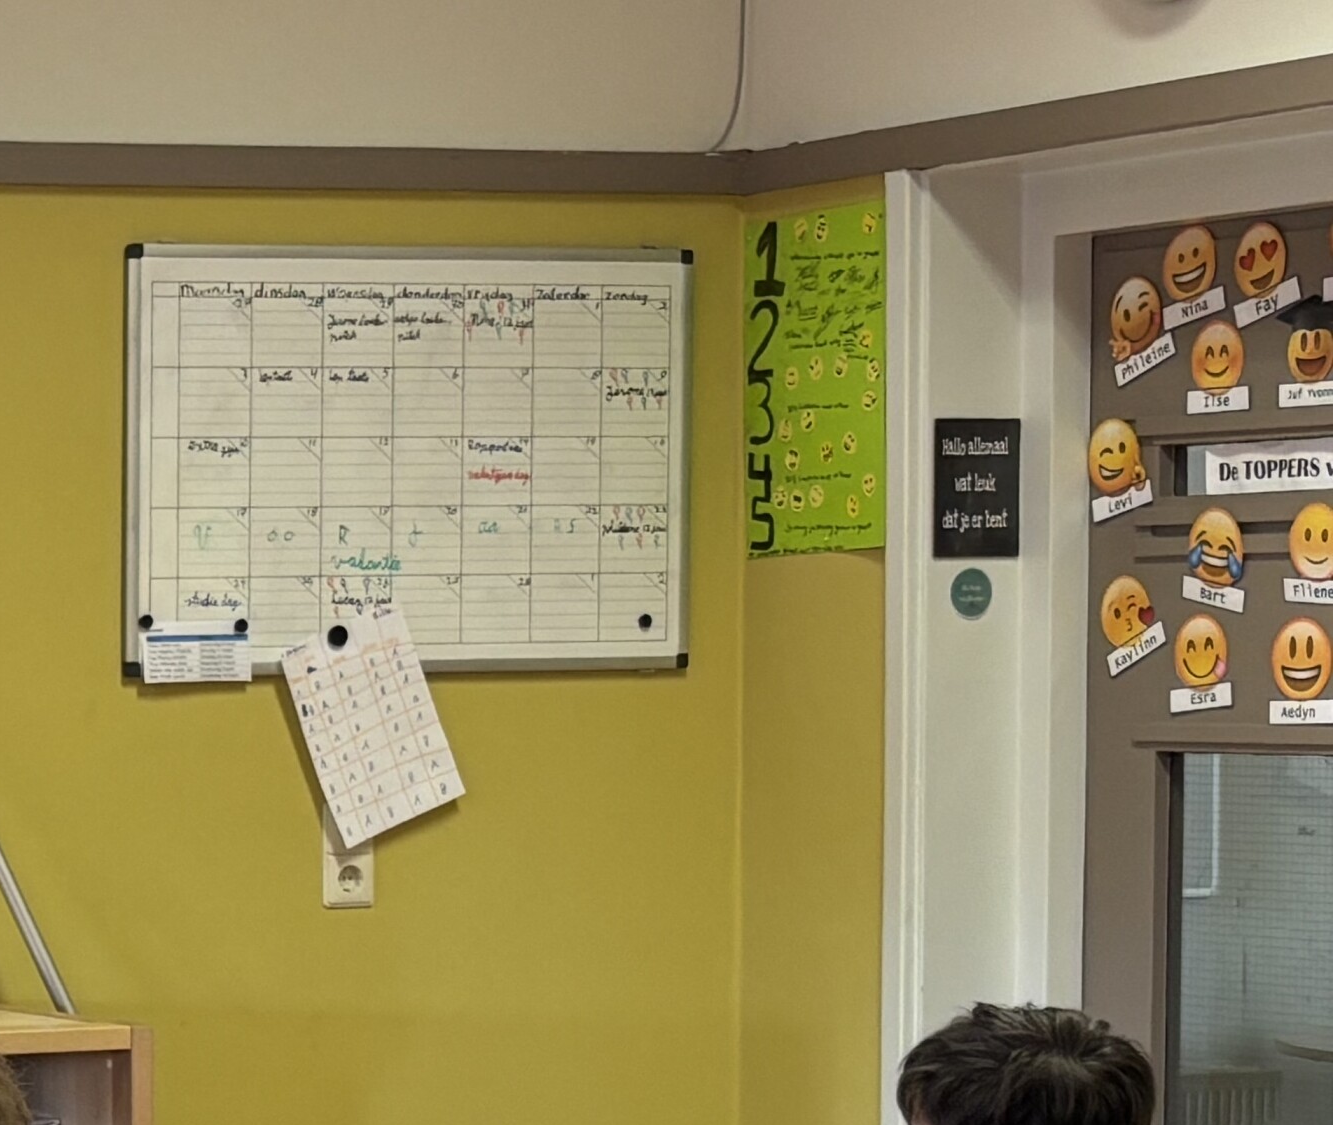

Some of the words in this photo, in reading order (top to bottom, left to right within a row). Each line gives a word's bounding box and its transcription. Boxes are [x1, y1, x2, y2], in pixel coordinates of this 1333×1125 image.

[754, 221, 785, 297] 1
[1181, 301, 1209, 318] Nina
[1255, 293, 1279, 316] Fay
[748, 300, 780, 380] 2
[1121, 341, 1172, 380] Phileine
[750, 377, 774, 445] 3
[1203, 394, 1230, 408] Ilse
[942, 437, 966, 455] Hallo
[748, 452, 772, 503] 4
[955, 472, 972, 491] wat
[974, 473, 996, 491] leuk
[1219, 462, 1238, 482] De
[1243, 458, 1320, 479] TOPPERS
[1108, 494, 1133, 513] Levi
[750, 496, 774, 550] 5
[942, 508, 958, 529] dat
[959, 510, 970, 533] je
[971, 512, 983, 529] er
[1200, 587, 1226, 605] Bart
[1114, 635, 1157, 669] Kaylinn
[1190, 691, 1217, 705] Esra
[1281, 705, 1316, 720] Aedyn
